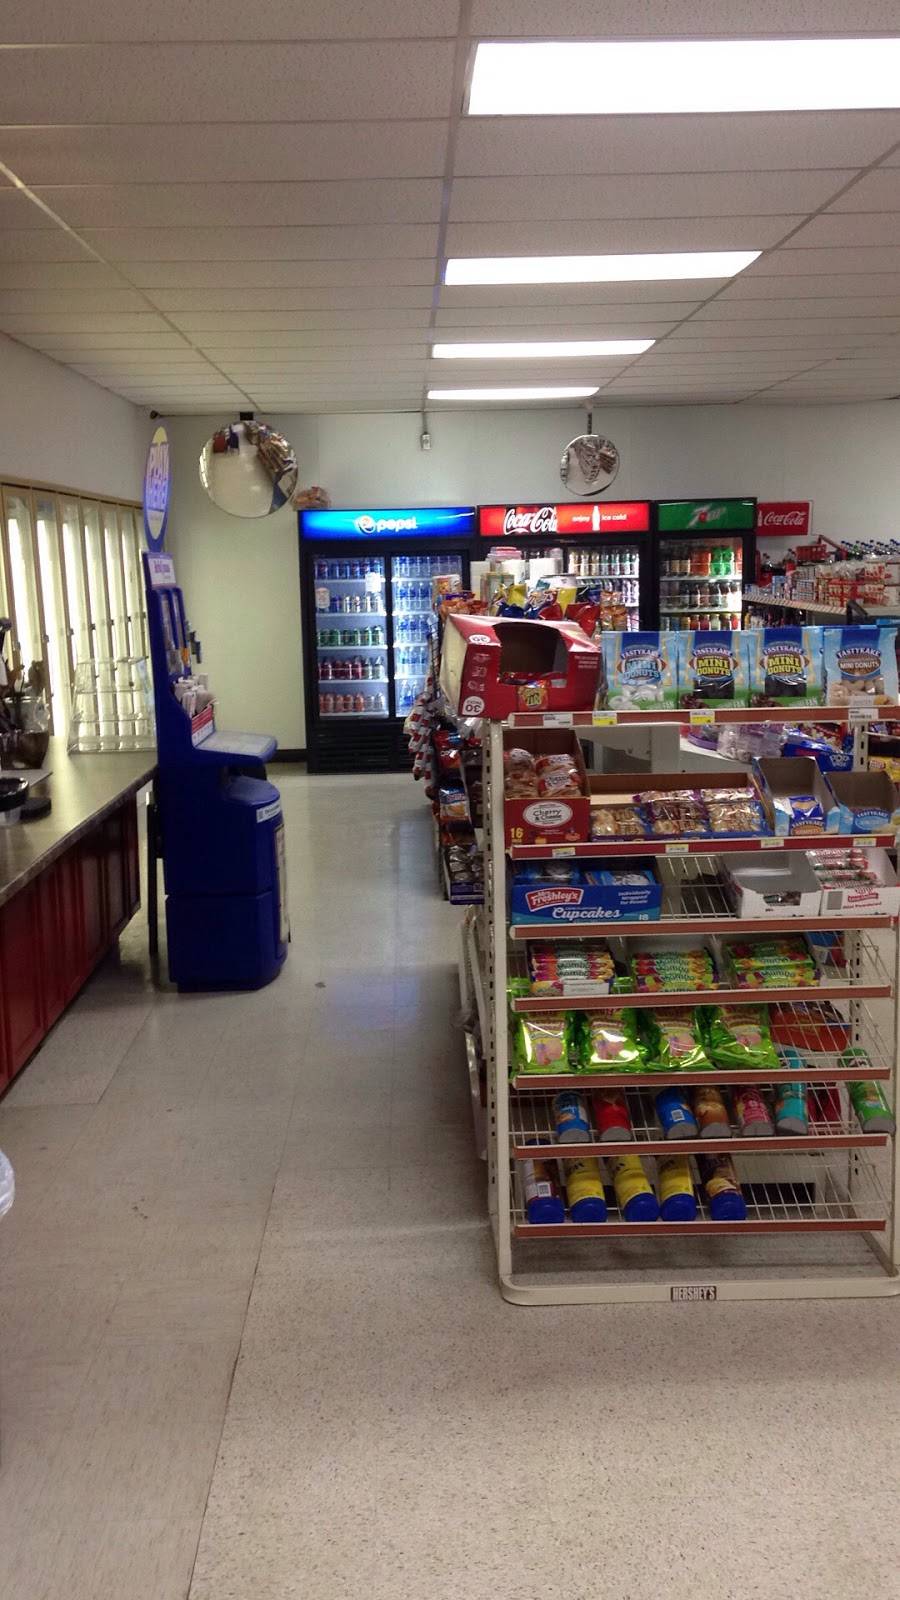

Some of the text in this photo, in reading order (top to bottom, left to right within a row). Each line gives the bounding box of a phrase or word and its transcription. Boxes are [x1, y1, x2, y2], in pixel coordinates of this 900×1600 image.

[612, 513, 627, 521] cold
[837, 647, 881, 658] TASTYKAKE
[697, 658, 729, 668] MINI
[768, 656, 800, 667] MINI
[840, 661, 880, 669] MINI DONUTS
[623, 669, 661, 679] DONUTS
[697, 667, 731, 676] DONUTS
[768, 665, 802, 674] DONUTS
[465, 704, 482, 713] 30
[533, 808, 562, 816] Cherry
[510, 827, 524, 838] 16
[531, 891, 578, 906] Freshley's
[552, 906, 622, 921] Cupcakes
[672, 1286, 716, 1300] HERSHEY'S
